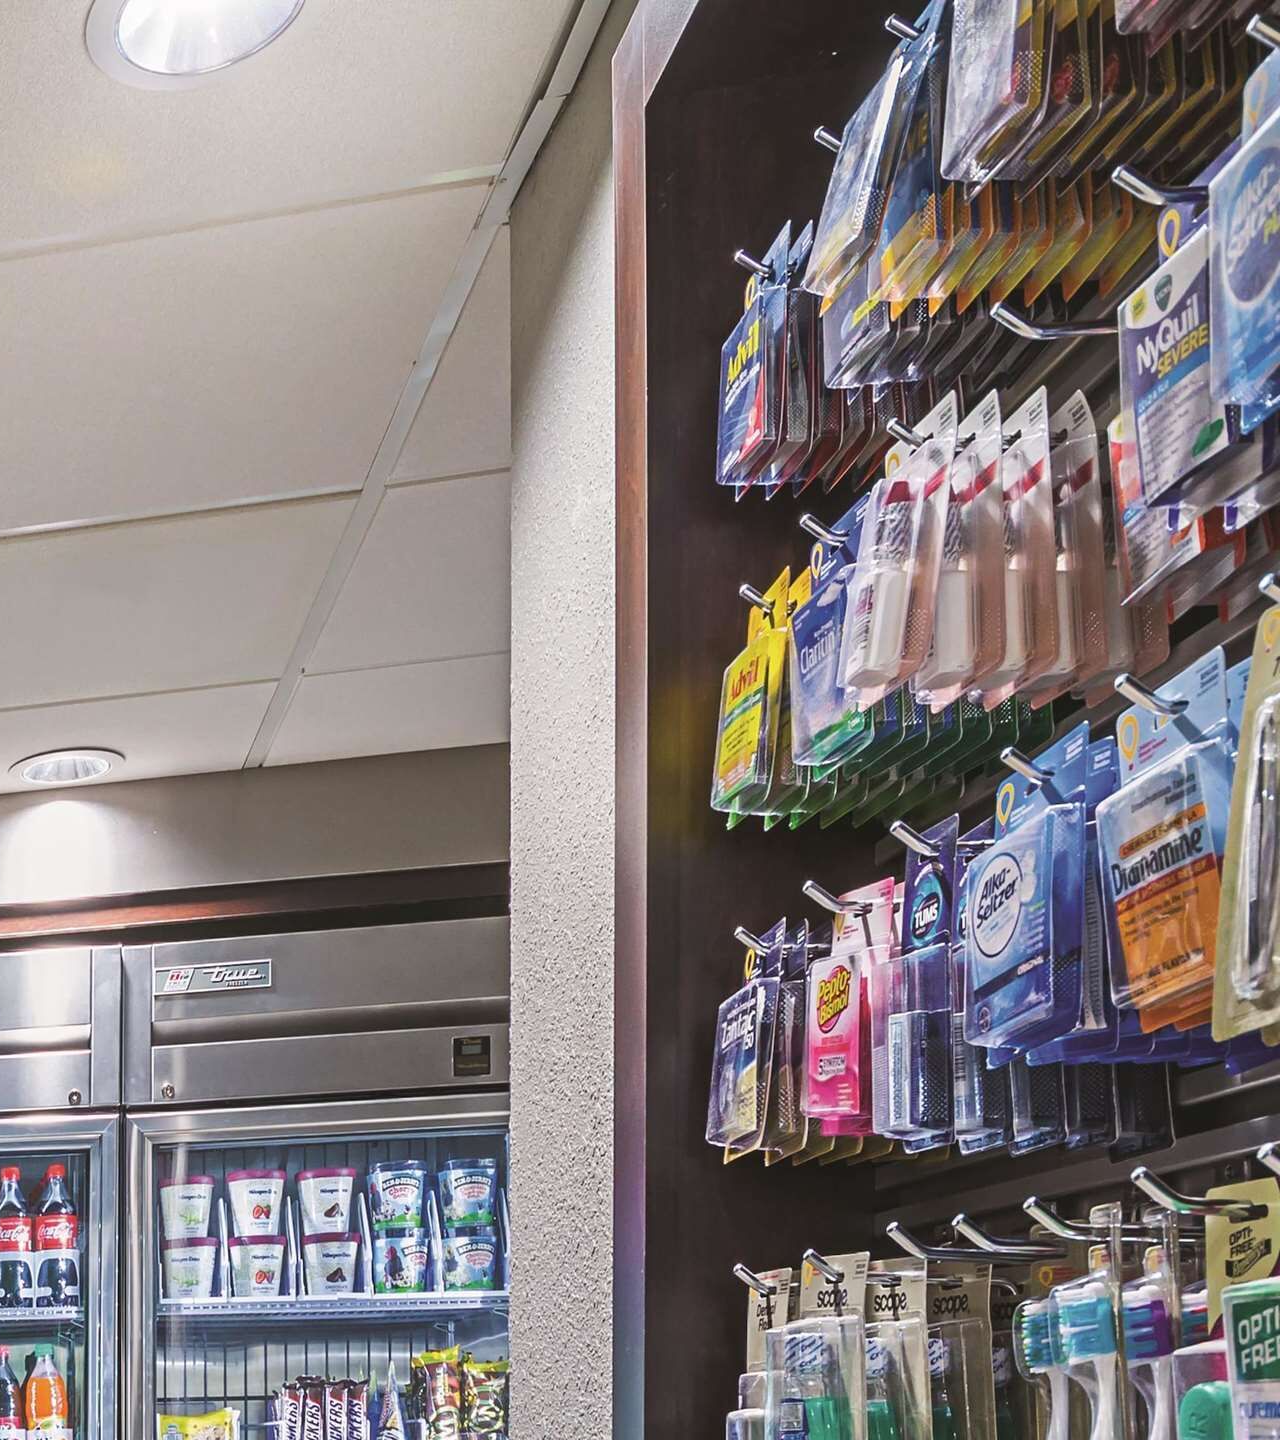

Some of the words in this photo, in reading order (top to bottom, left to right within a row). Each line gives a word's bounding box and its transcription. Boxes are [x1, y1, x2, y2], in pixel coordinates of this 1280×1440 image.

[727, 319, 760, 383] Advil
[1136, 292, 1201, 377] NyQuil
[1157, 323, 1209, 381] SEVERE
[800, 631, 836, 676] Claritin
[729, 658, 760, 701] Advil
[975, 880, 1018, 929] Seltzer
[978, 869, 1013, 905] Alka-
[913, 903, 939, 932] TUMS
[203, 967, 263, 984] true
[817, 967, 851, 1002] Pepto-
[819, 989, 849, 1023] Bismol
[722, 1004, 756, 1050] Zantac
[1228, 1225, 1255, 1246] OPTI-
[1230, 1239, 1255, 1258] FREE
[817, 1288, 848, 1310] scope
[873, 1291, 907, 1313] scope
[931, 1293, 970, 1316] scope
